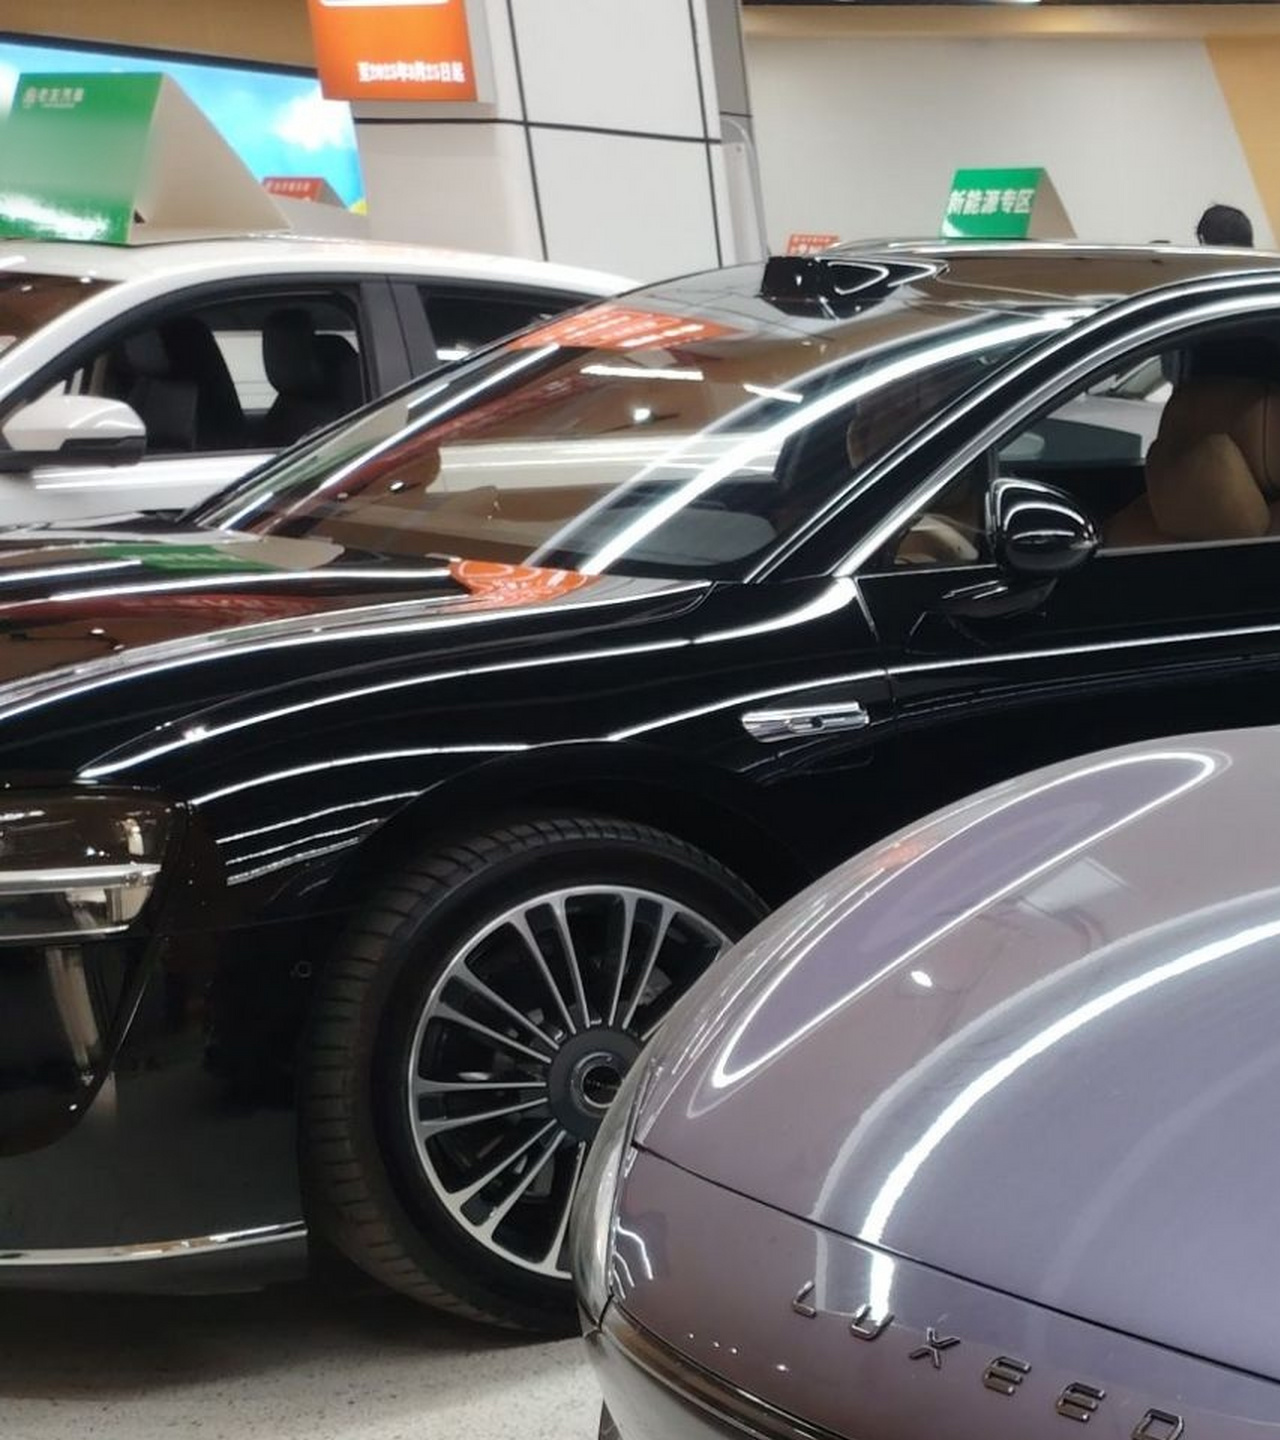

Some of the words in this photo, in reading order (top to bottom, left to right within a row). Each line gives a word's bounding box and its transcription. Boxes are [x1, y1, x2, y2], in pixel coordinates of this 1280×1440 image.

[947, 188, 1035, 215] 新能源专区
